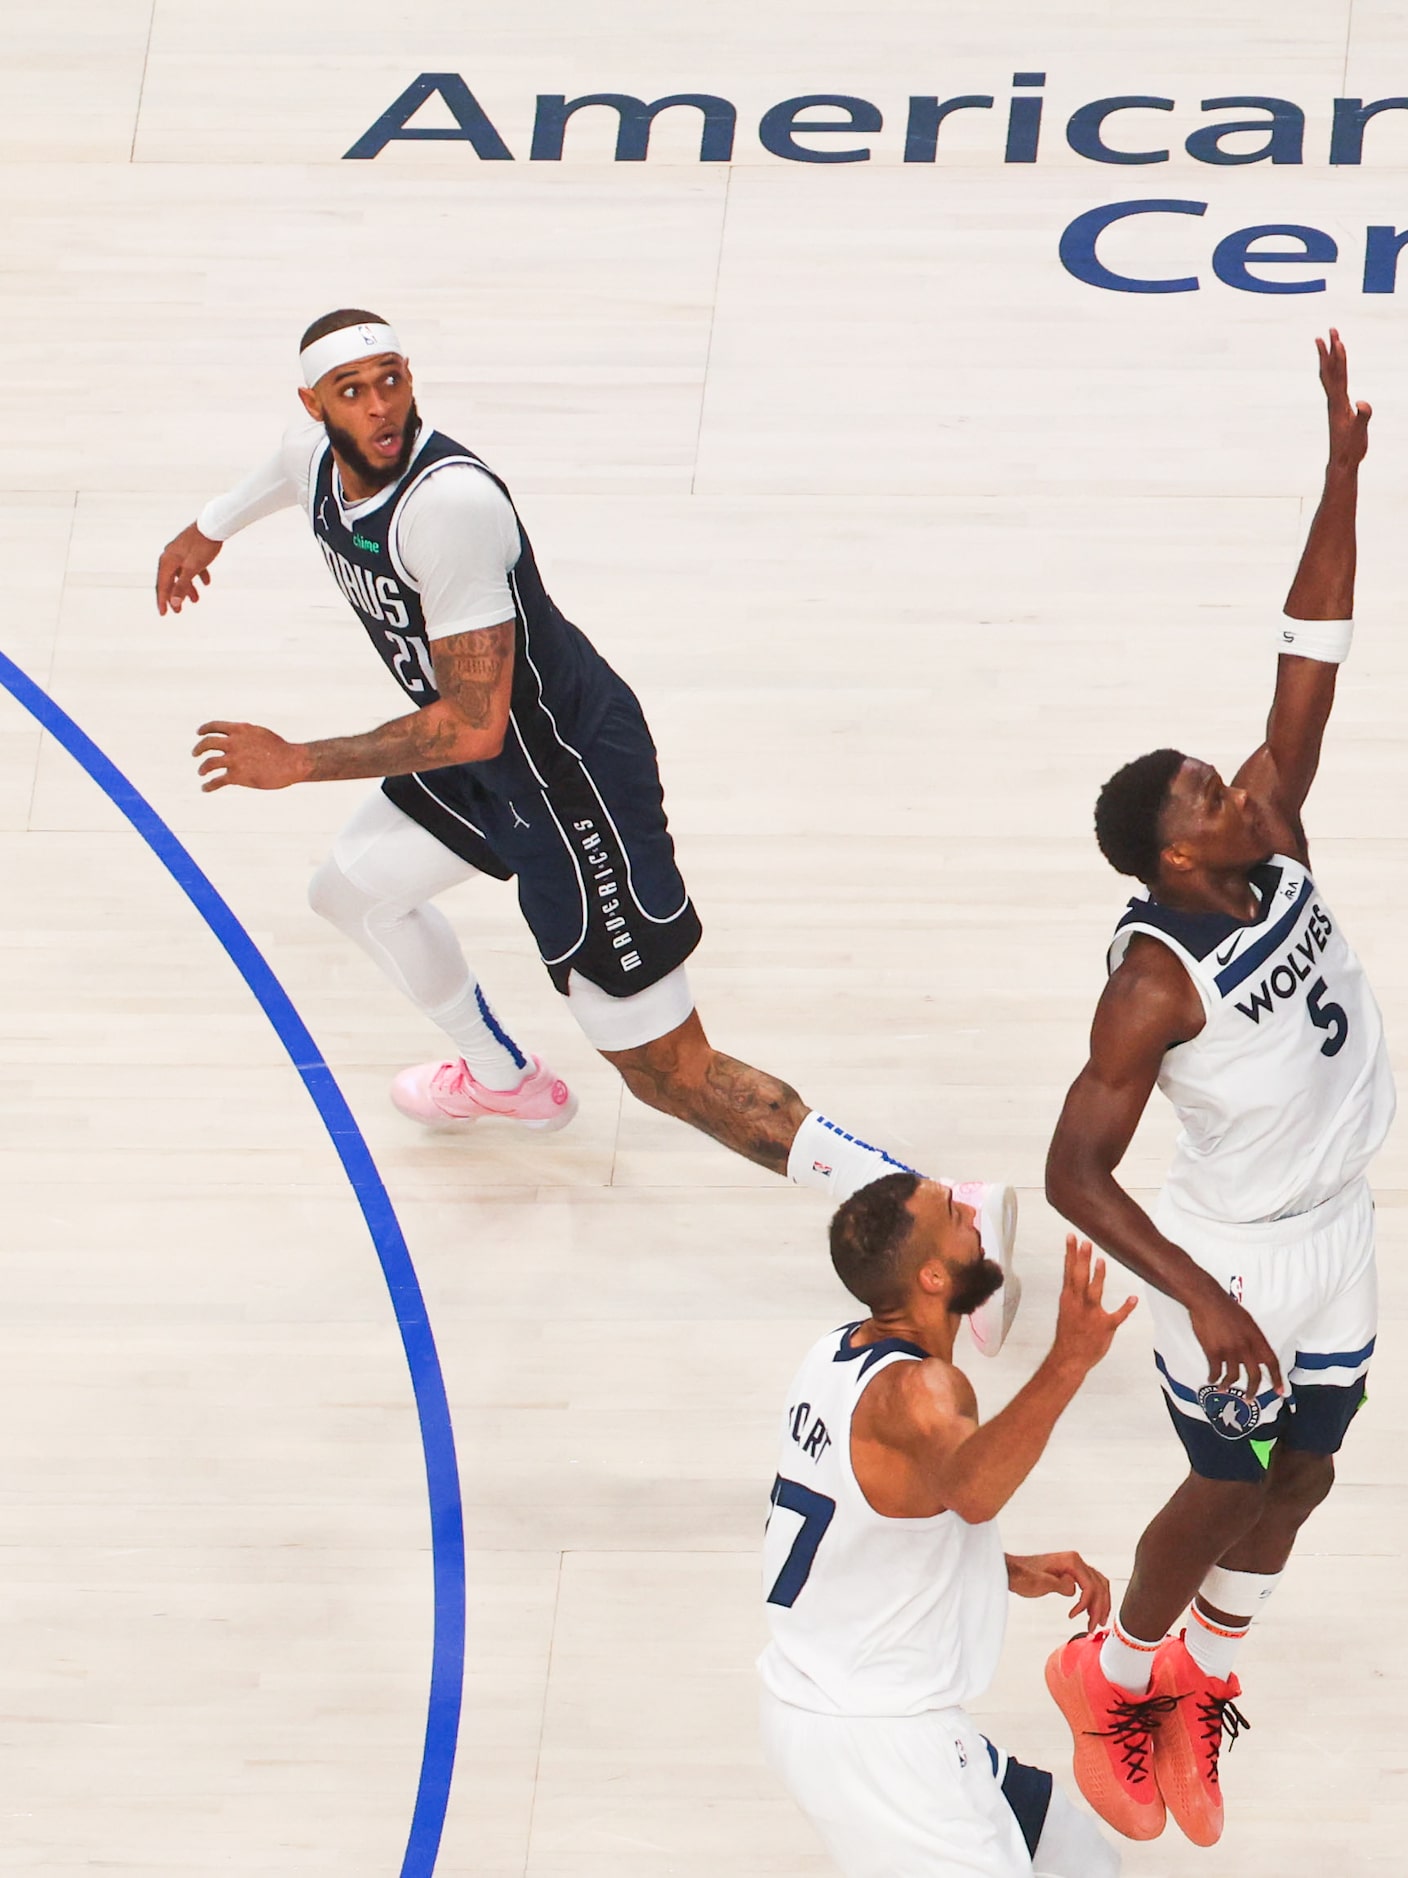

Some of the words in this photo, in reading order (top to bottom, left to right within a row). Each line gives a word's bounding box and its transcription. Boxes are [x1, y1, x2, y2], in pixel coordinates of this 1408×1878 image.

[353, 533, 379, 553] chime
[385, 630, 437, 691] 21
[573, 818, 643, 972] MAVERICKS
[1234, 904, 1332, 1024] WOLVES
[1306, 976, 1348, 1058] 5
[764, 1472, 836, 1608] 7
